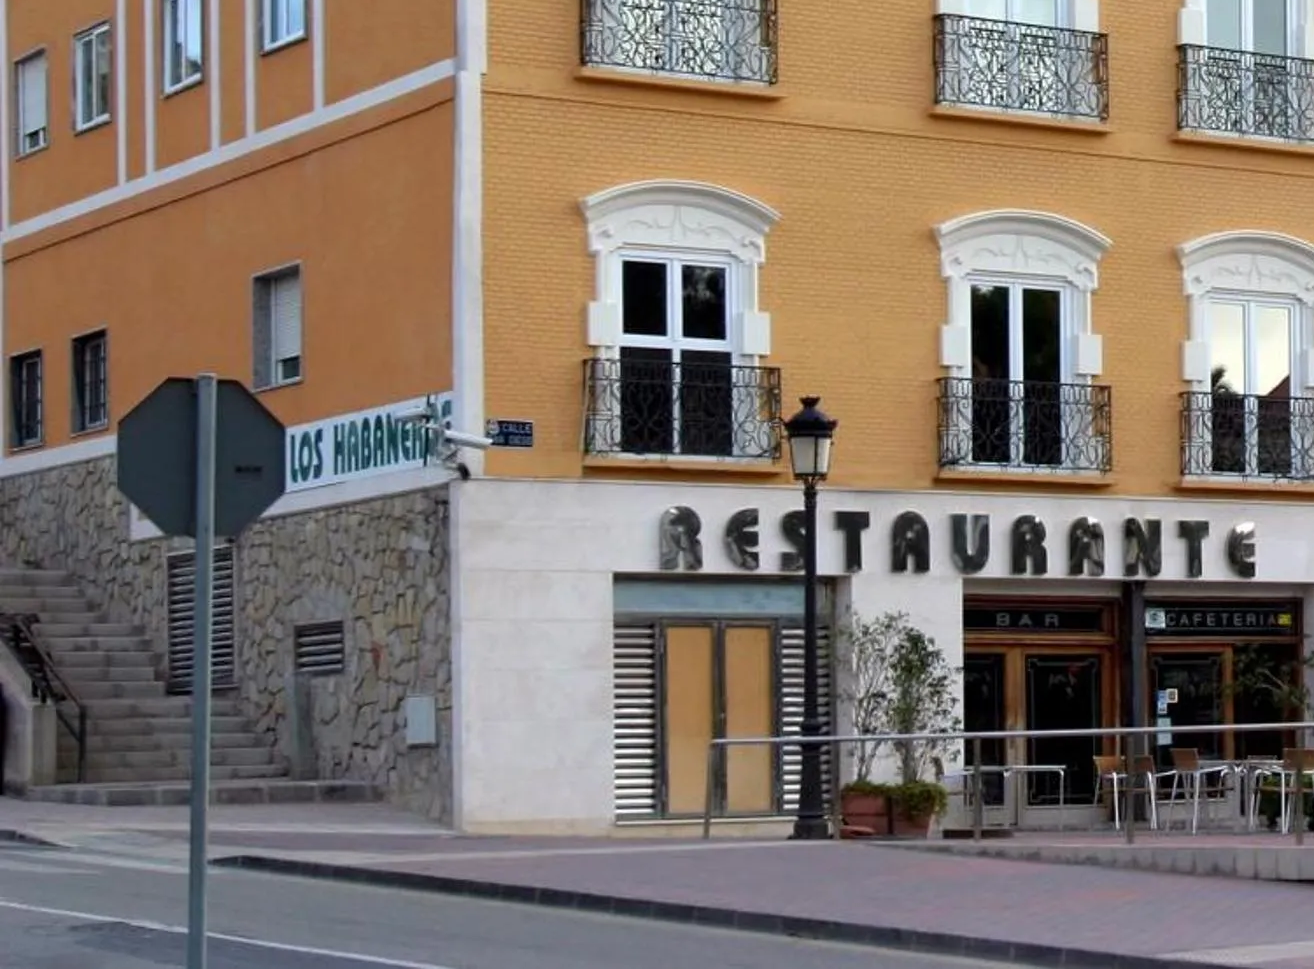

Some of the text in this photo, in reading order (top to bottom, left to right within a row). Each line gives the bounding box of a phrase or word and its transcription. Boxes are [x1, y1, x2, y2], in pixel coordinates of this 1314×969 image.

[290, 399, 452, 483] LOS HABANER
[659, 505, 1256, 578] RESTAURANTE
[996, 612, 1060, 627] BAR
[1166, 612, 1278, 627] CAFETERIA
